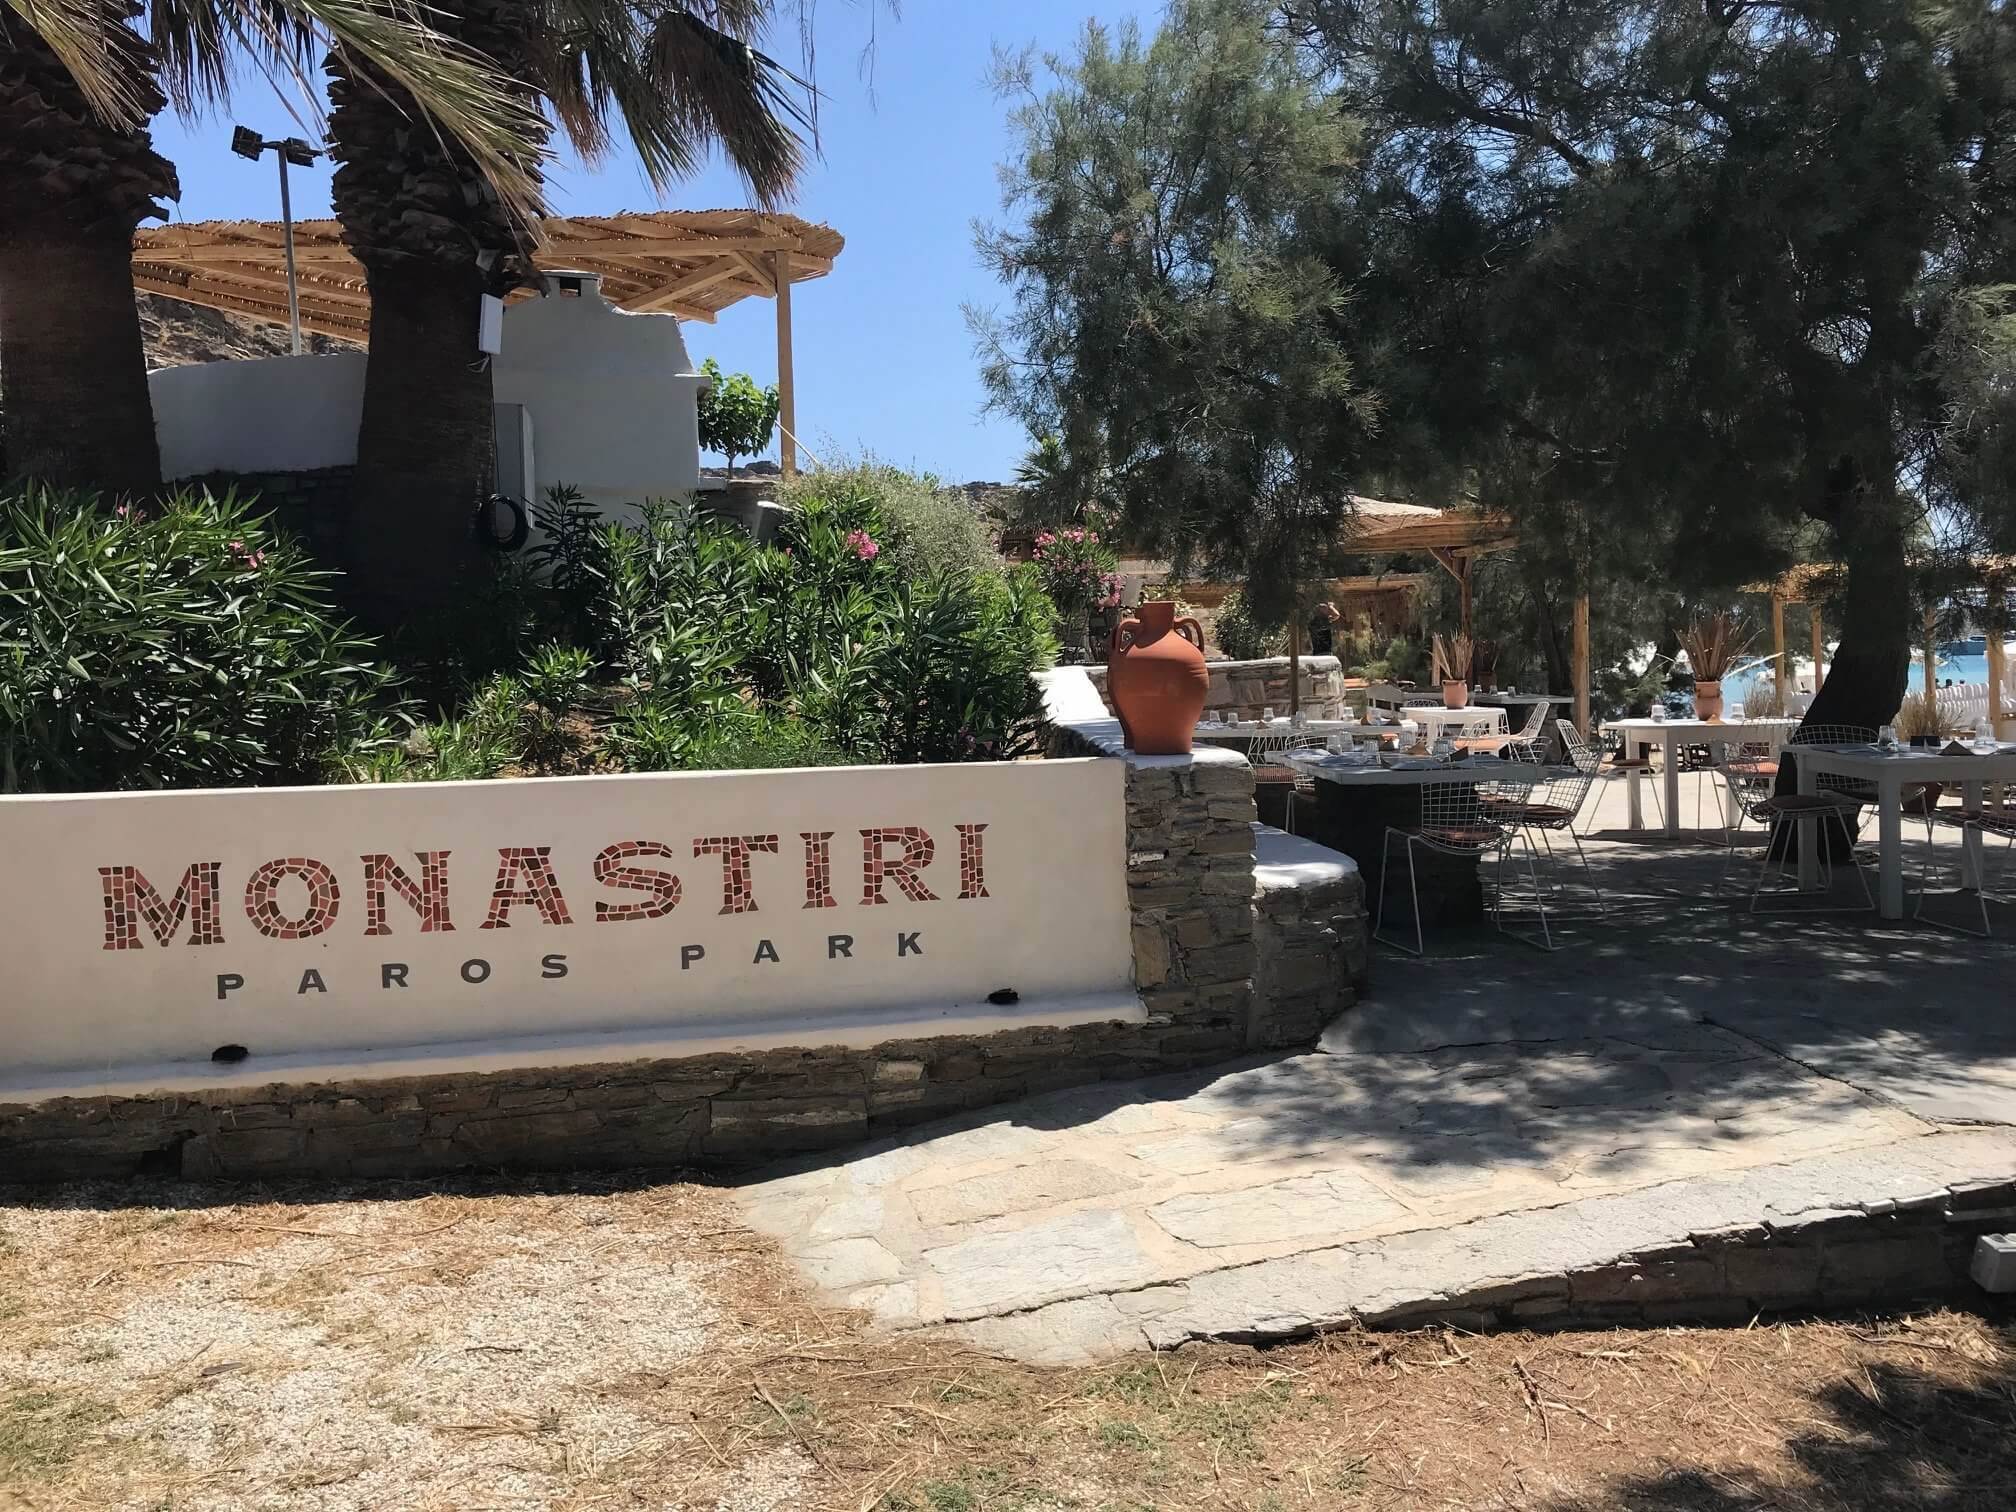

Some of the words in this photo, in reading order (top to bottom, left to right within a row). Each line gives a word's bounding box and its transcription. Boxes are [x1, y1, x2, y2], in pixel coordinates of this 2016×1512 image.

[97, 823, 990, 950] MONASTIRI
[217, 954, 569, 1000] PAROS
[680, 932, 923, 970] PARK
